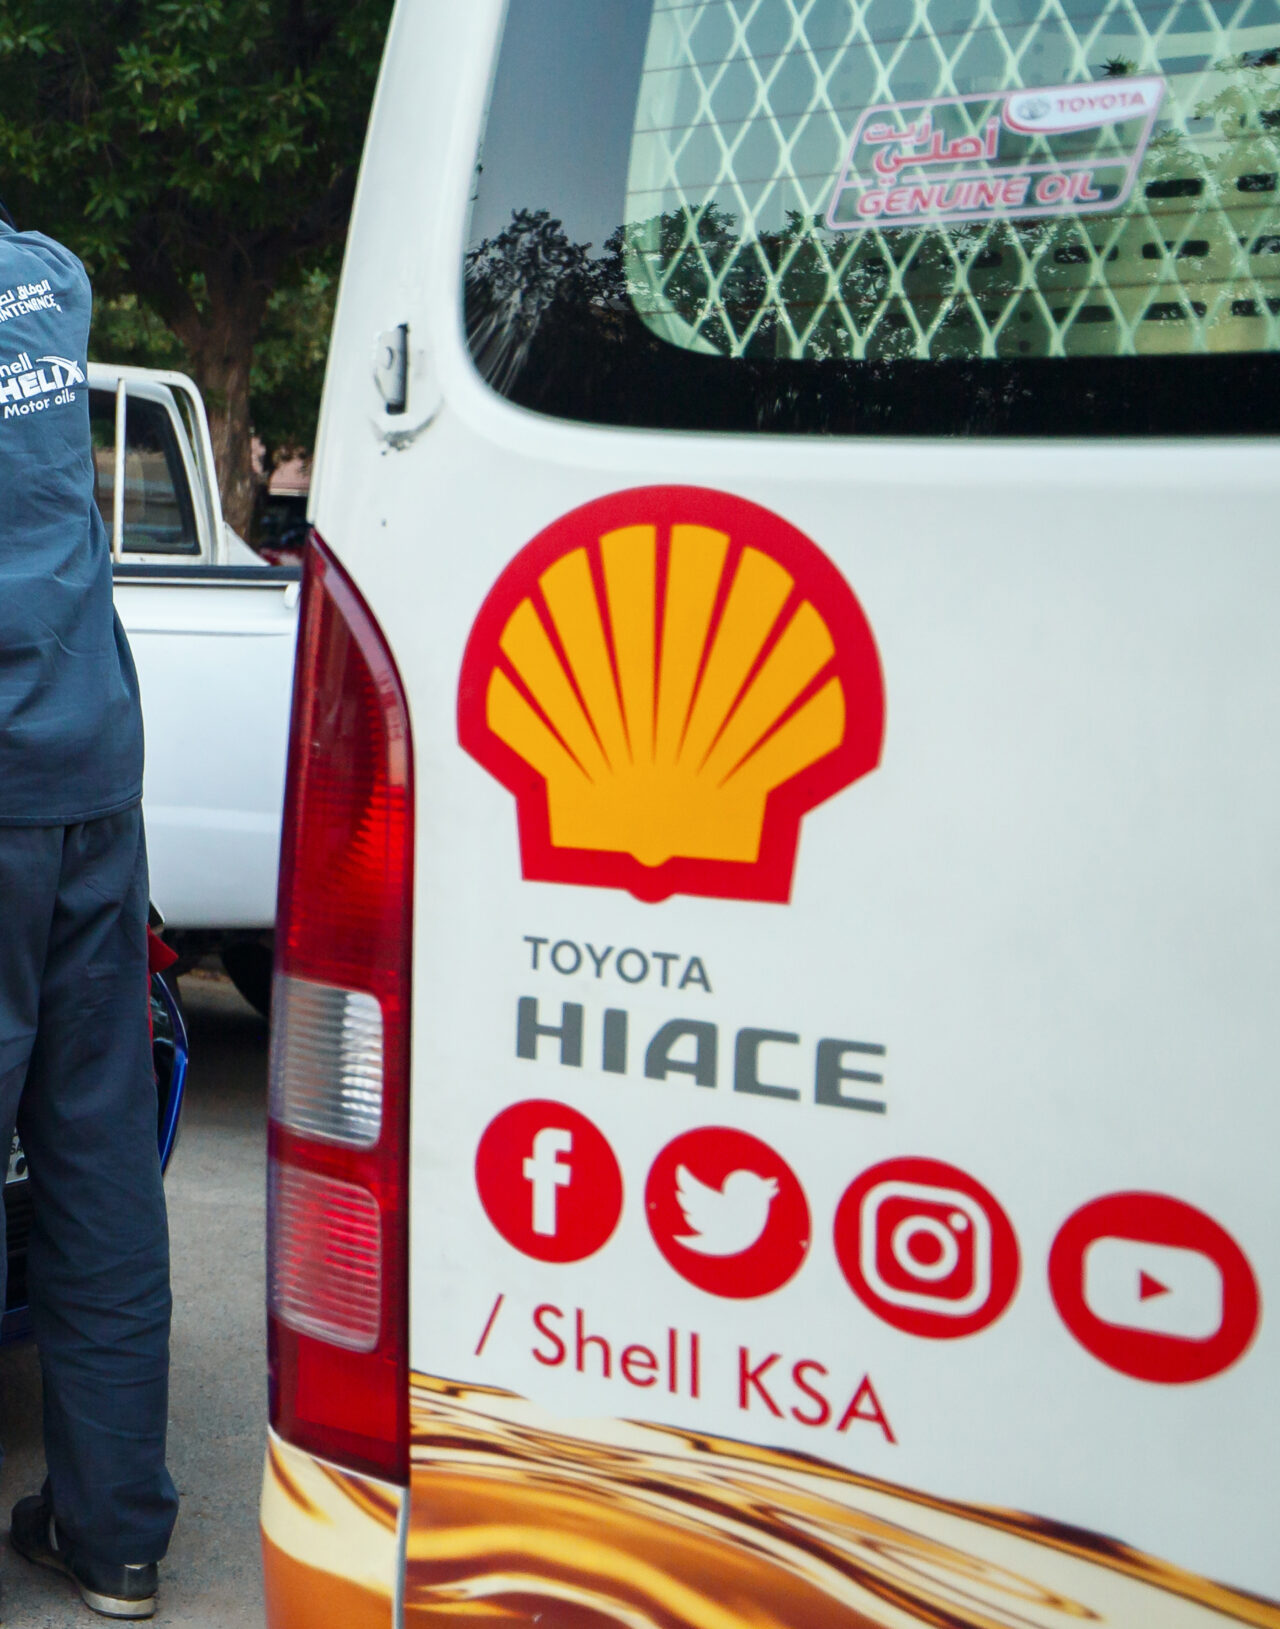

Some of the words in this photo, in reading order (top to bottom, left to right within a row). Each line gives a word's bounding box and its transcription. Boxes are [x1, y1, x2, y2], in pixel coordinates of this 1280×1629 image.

[1055, 91, 1146, 114] TOYOTA
[863, 112, 933, 146] زيت
[873, 117, 1000, 182] أصلي
[857, 176, 1030, 216] GENUINE
[1035, 172, 1102, 203] OIL
[17, 279, 52, 300] الوفاق
[4, 398, 50, 419] Motor
[54, 389, 76, 407] oils
[523, 935, 713, 994] TOYOTA
[516, 996, 887, 1114] HIACE
[532, 1304, 700, 1399] Shell
[738, 1346, 898, 1446] KSA
